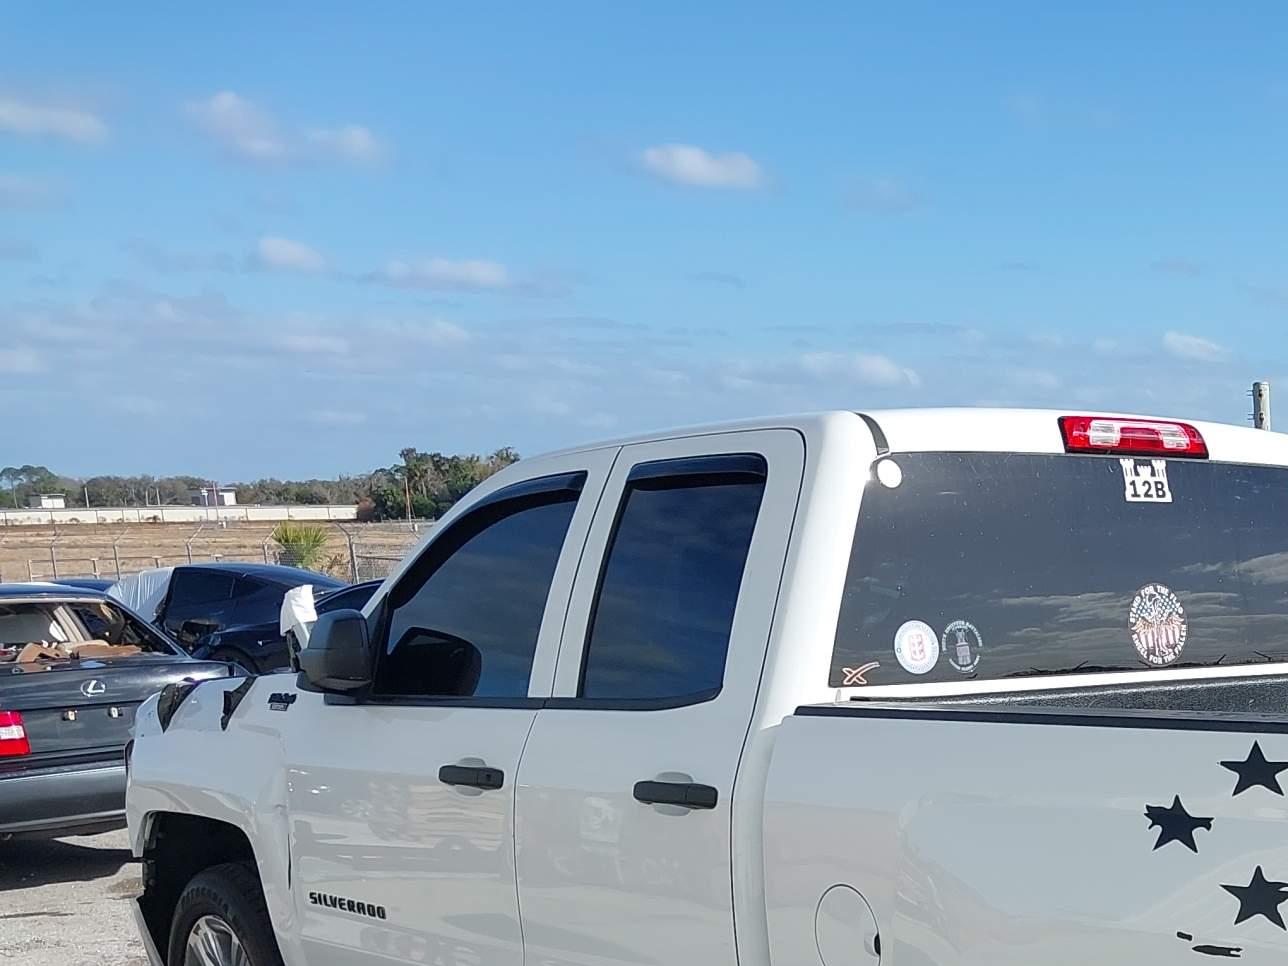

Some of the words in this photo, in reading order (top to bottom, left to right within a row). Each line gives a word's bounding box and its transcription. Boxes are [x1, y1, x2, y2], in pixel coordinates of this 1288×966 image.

[1129, 480, 1167, 498] 12B
[1129, 596, 1141, 623] STAND
[1141, 586, 1155, 598] FOR
[1156, 585, 1169, 596] THE
[1169, 593, 1184, 615] FLAG
[1149, 654, 1163, 664] FOR
[1163, 653, 1176, 663] THE
[308, 891, 387, 920] SILVERADO
